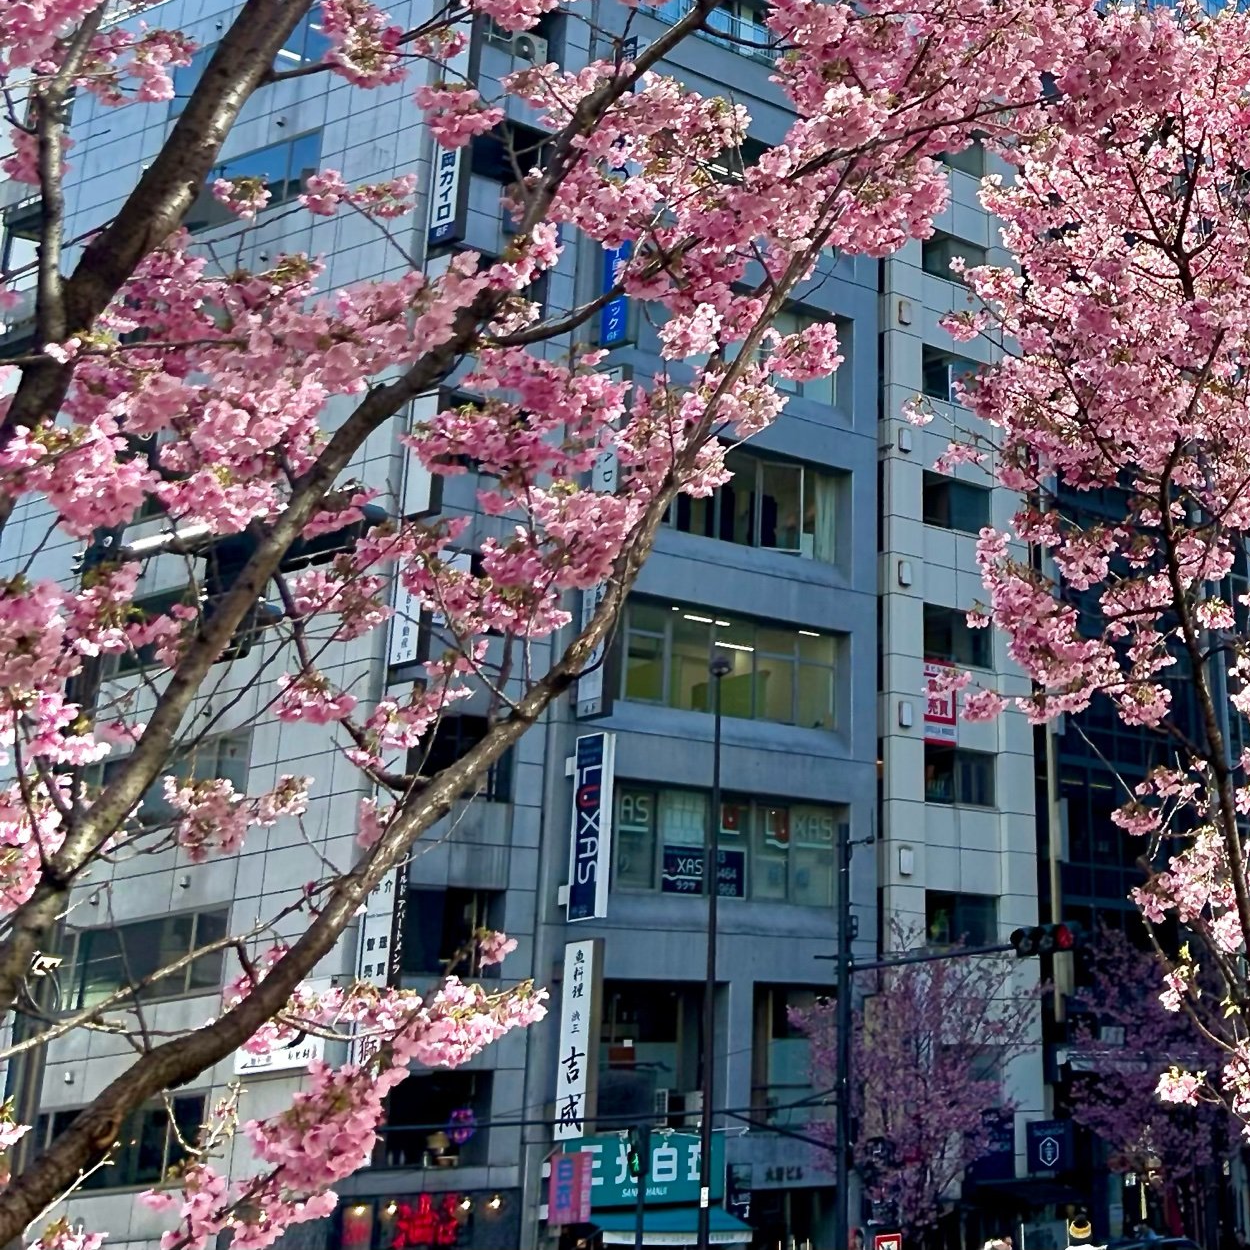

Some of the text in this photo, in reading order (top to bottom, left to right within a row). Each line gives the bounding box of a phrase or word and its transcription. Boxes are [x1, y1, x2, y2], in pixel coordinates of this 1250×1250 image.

[577, 764, 602, 884] LUXAS
[363, 961, 386, 979] 売買
[571, 949, 586, 999] 魚料理
[559, 1046, 586, 1135] 吉成
